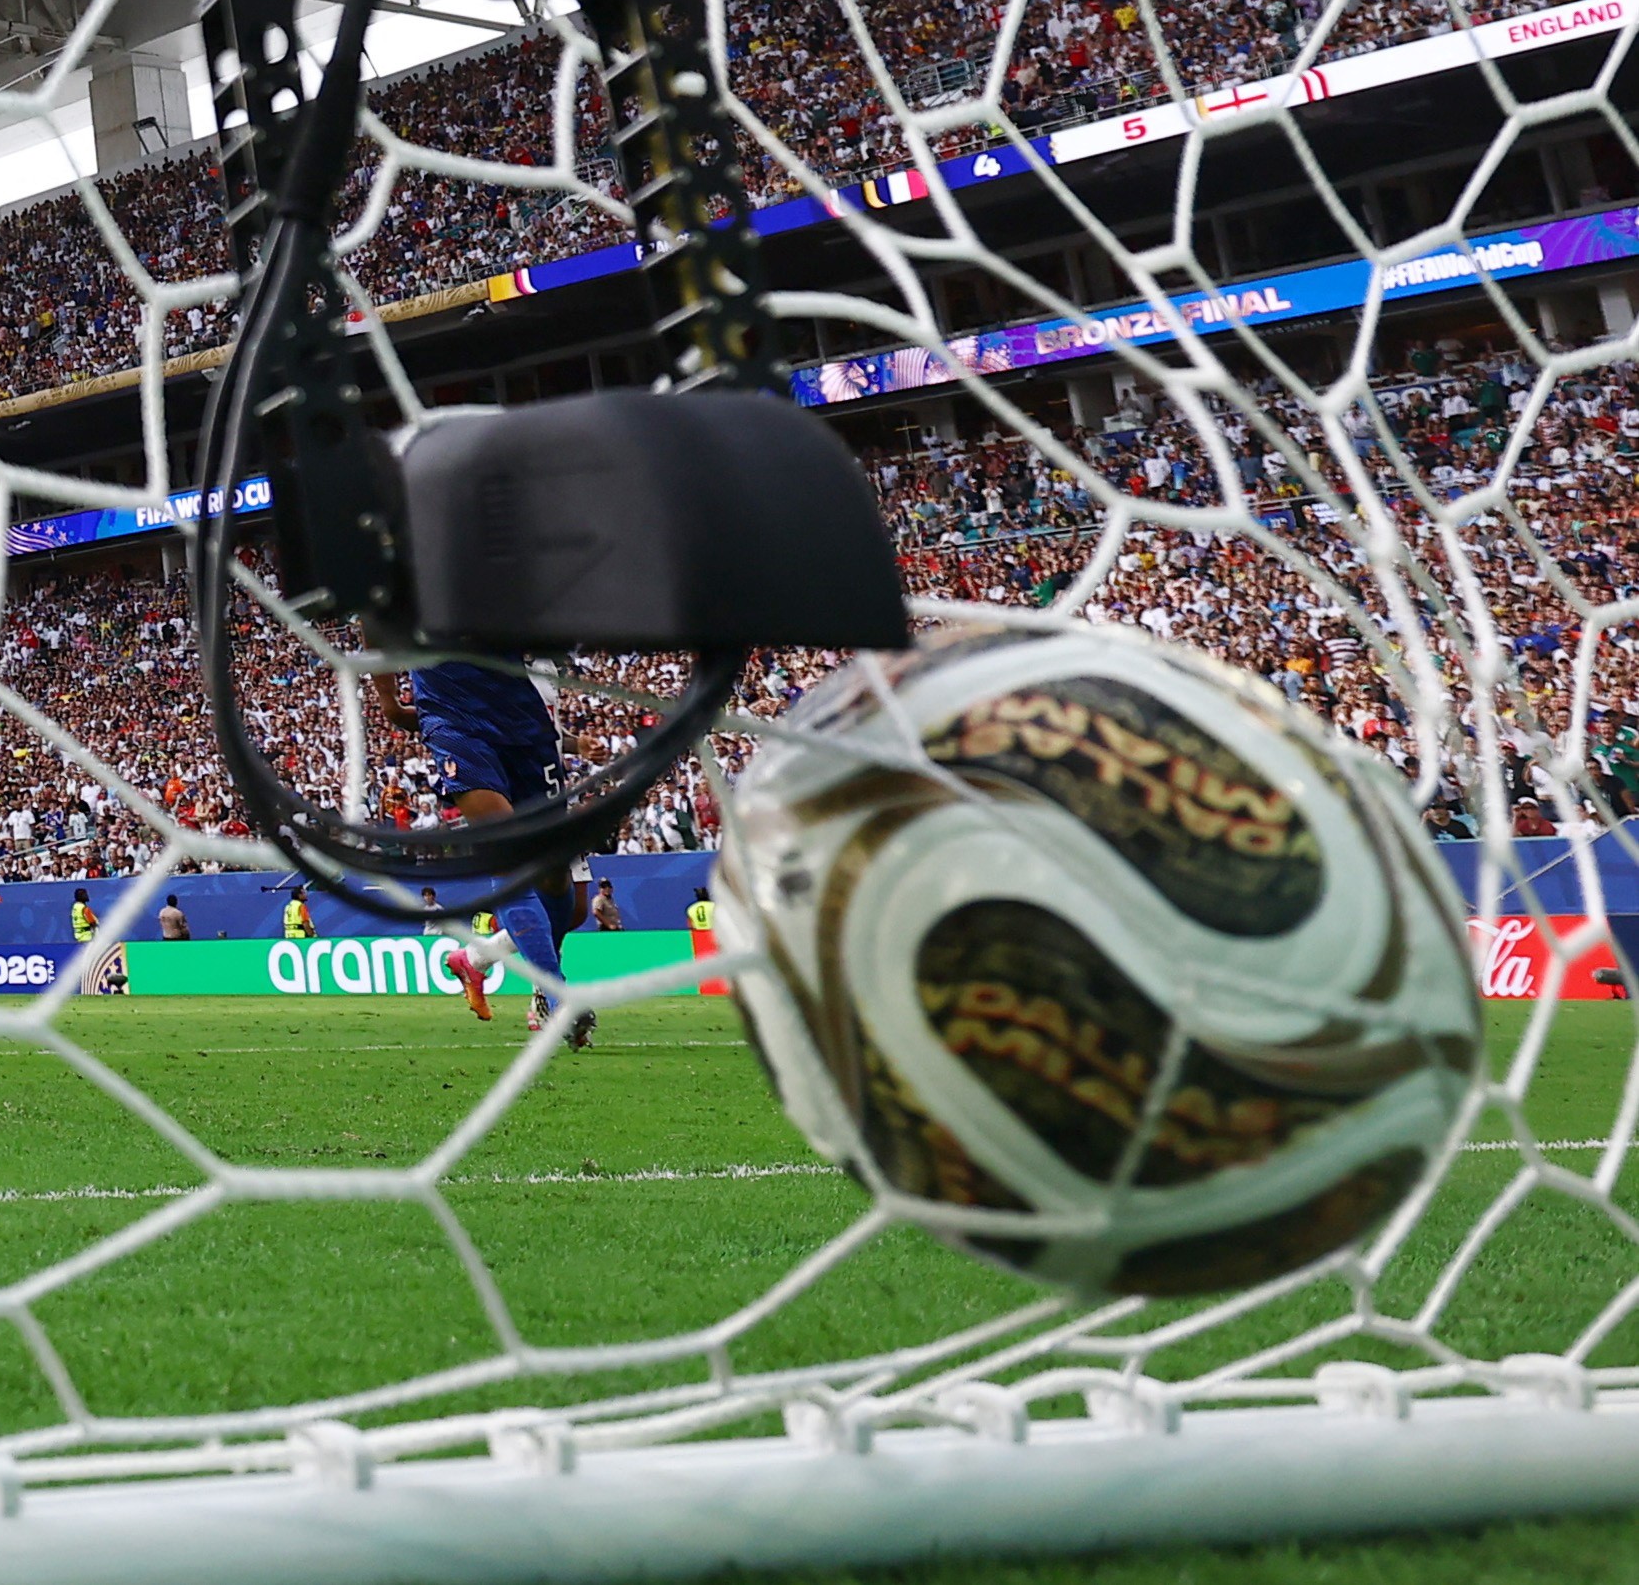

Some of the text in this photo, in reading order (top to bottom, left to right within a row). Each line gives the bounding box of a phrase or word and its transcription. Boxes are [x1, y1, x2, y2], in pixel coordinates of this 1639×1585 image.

[1507, 1, 1623, 44] ENGLAND
[1122, 117, 1148, 141] 5
[972, 152, 1002, 178] 4
[1381, 241, 1544, 291] #FIFAWorldCup
[1182, 287, 1293, 327] FINAL
